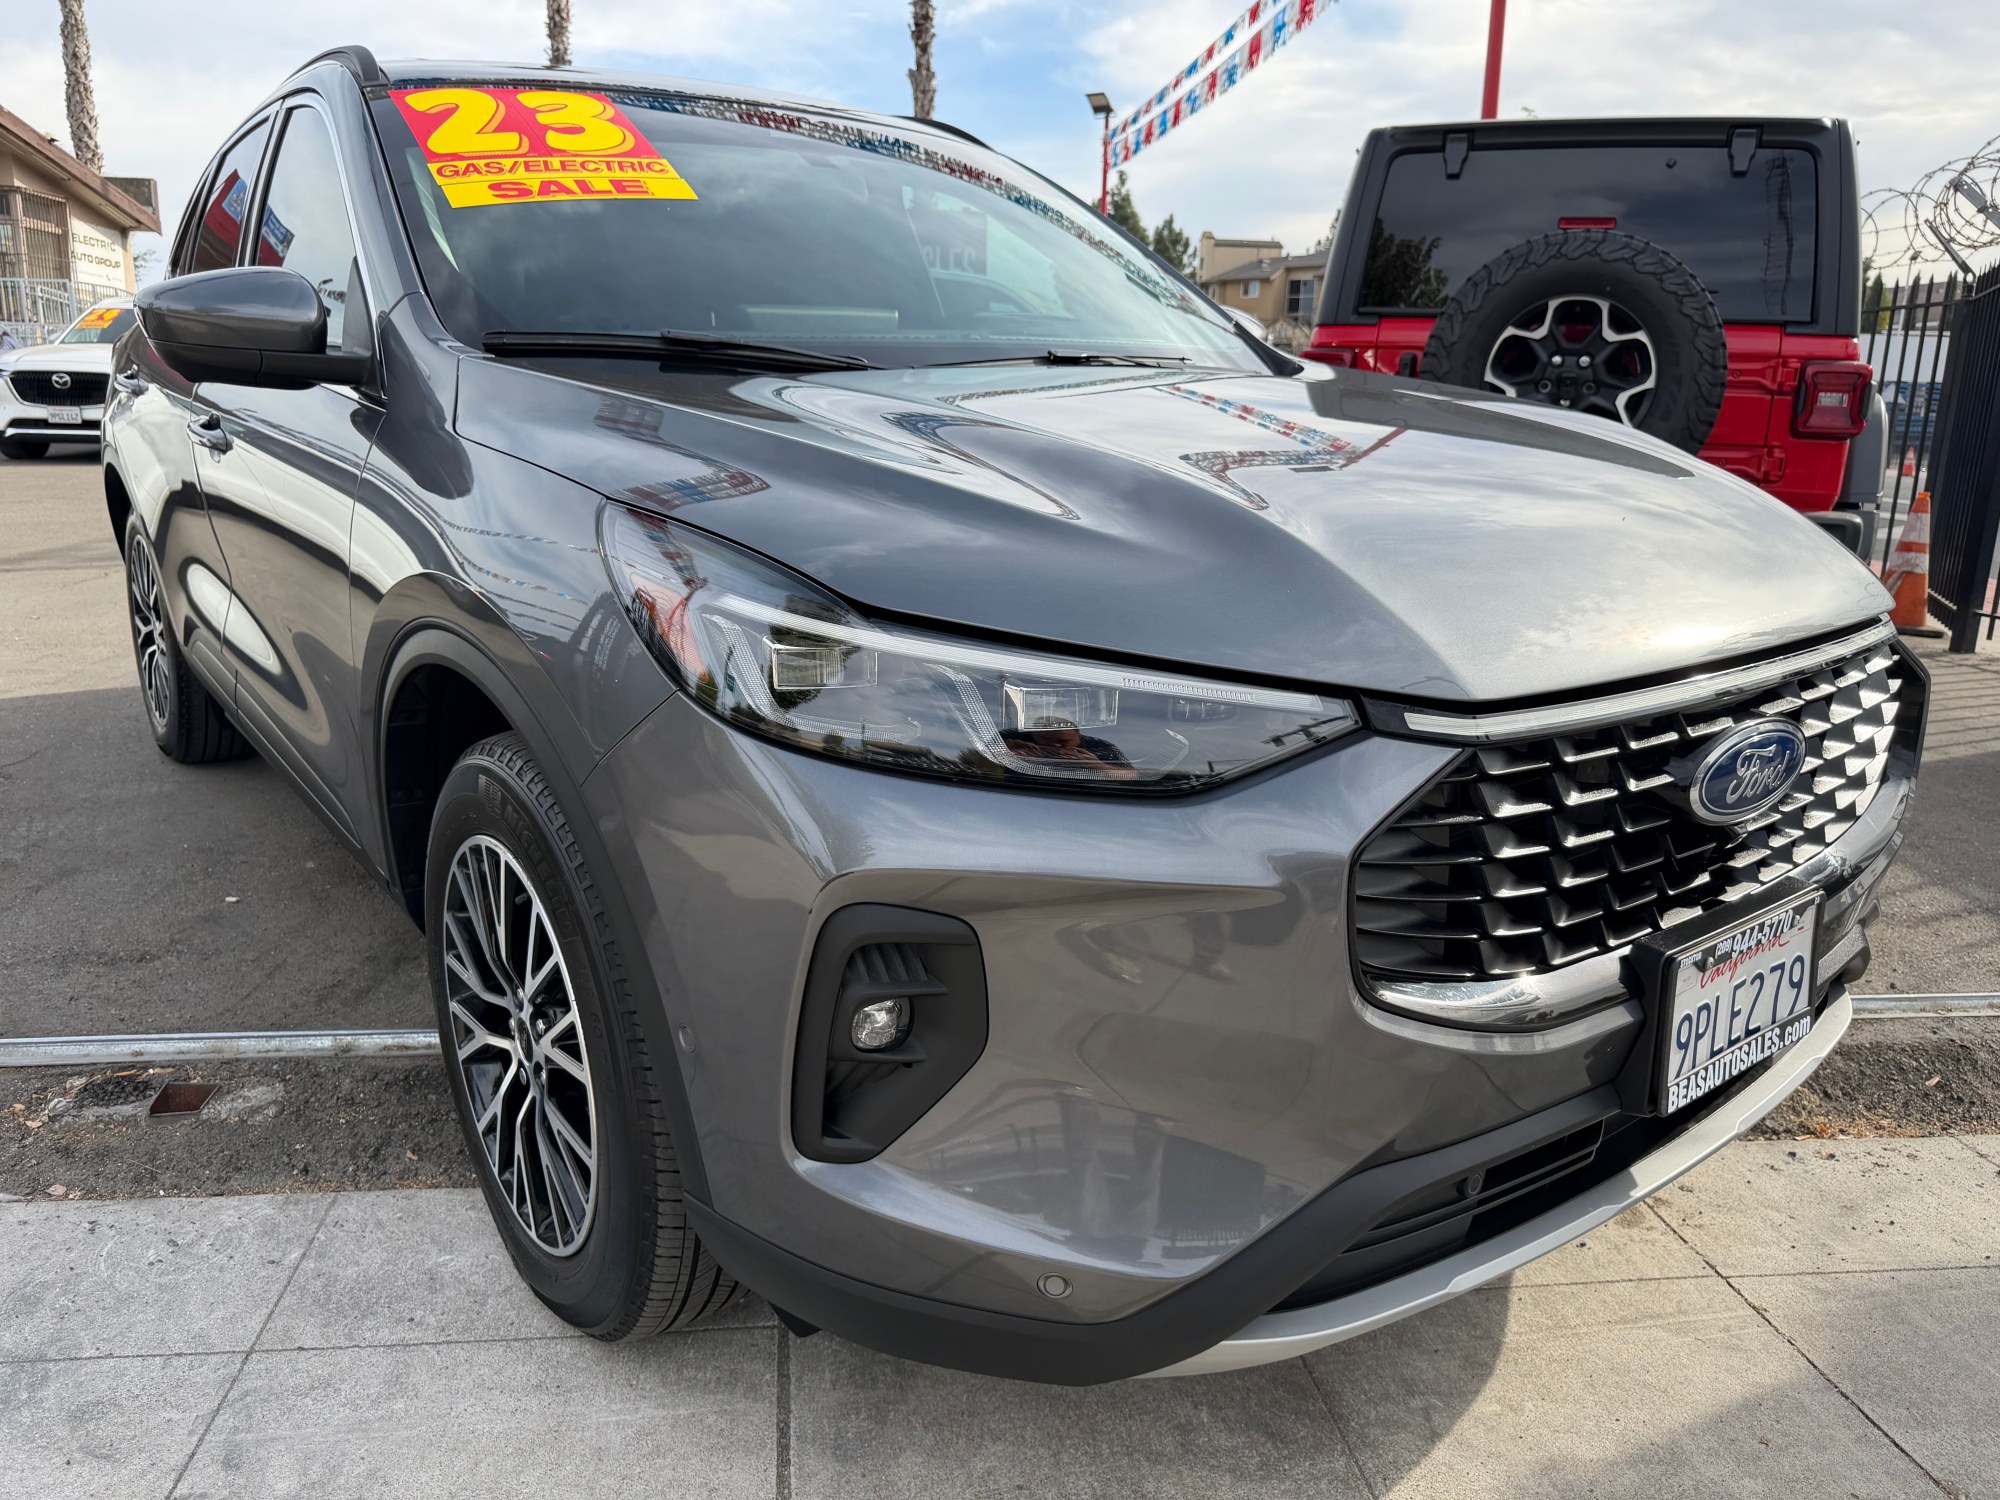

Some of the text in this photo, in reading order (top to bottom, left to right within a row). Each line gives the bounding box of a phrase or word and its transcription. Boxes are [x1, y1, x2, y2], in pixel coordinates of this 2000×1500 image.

[405, 89, 634, 155] 23
[436, 159, 669, 179] GAS/ELECTRIC
[487, 178, 655, 199] SALE
[71, 251, 121, 268] AUTO GROUP
[72, 232, 116, 252] ELECTRIC
[1726, 744, 1790, 804] Ford
[1715, 908, 1794, 959] (209) 944-5770
[1674, 954, 1805, 1081] 9PLE279
[1668, 1015, 1811, 1114] BEASAUTOSALES.com
